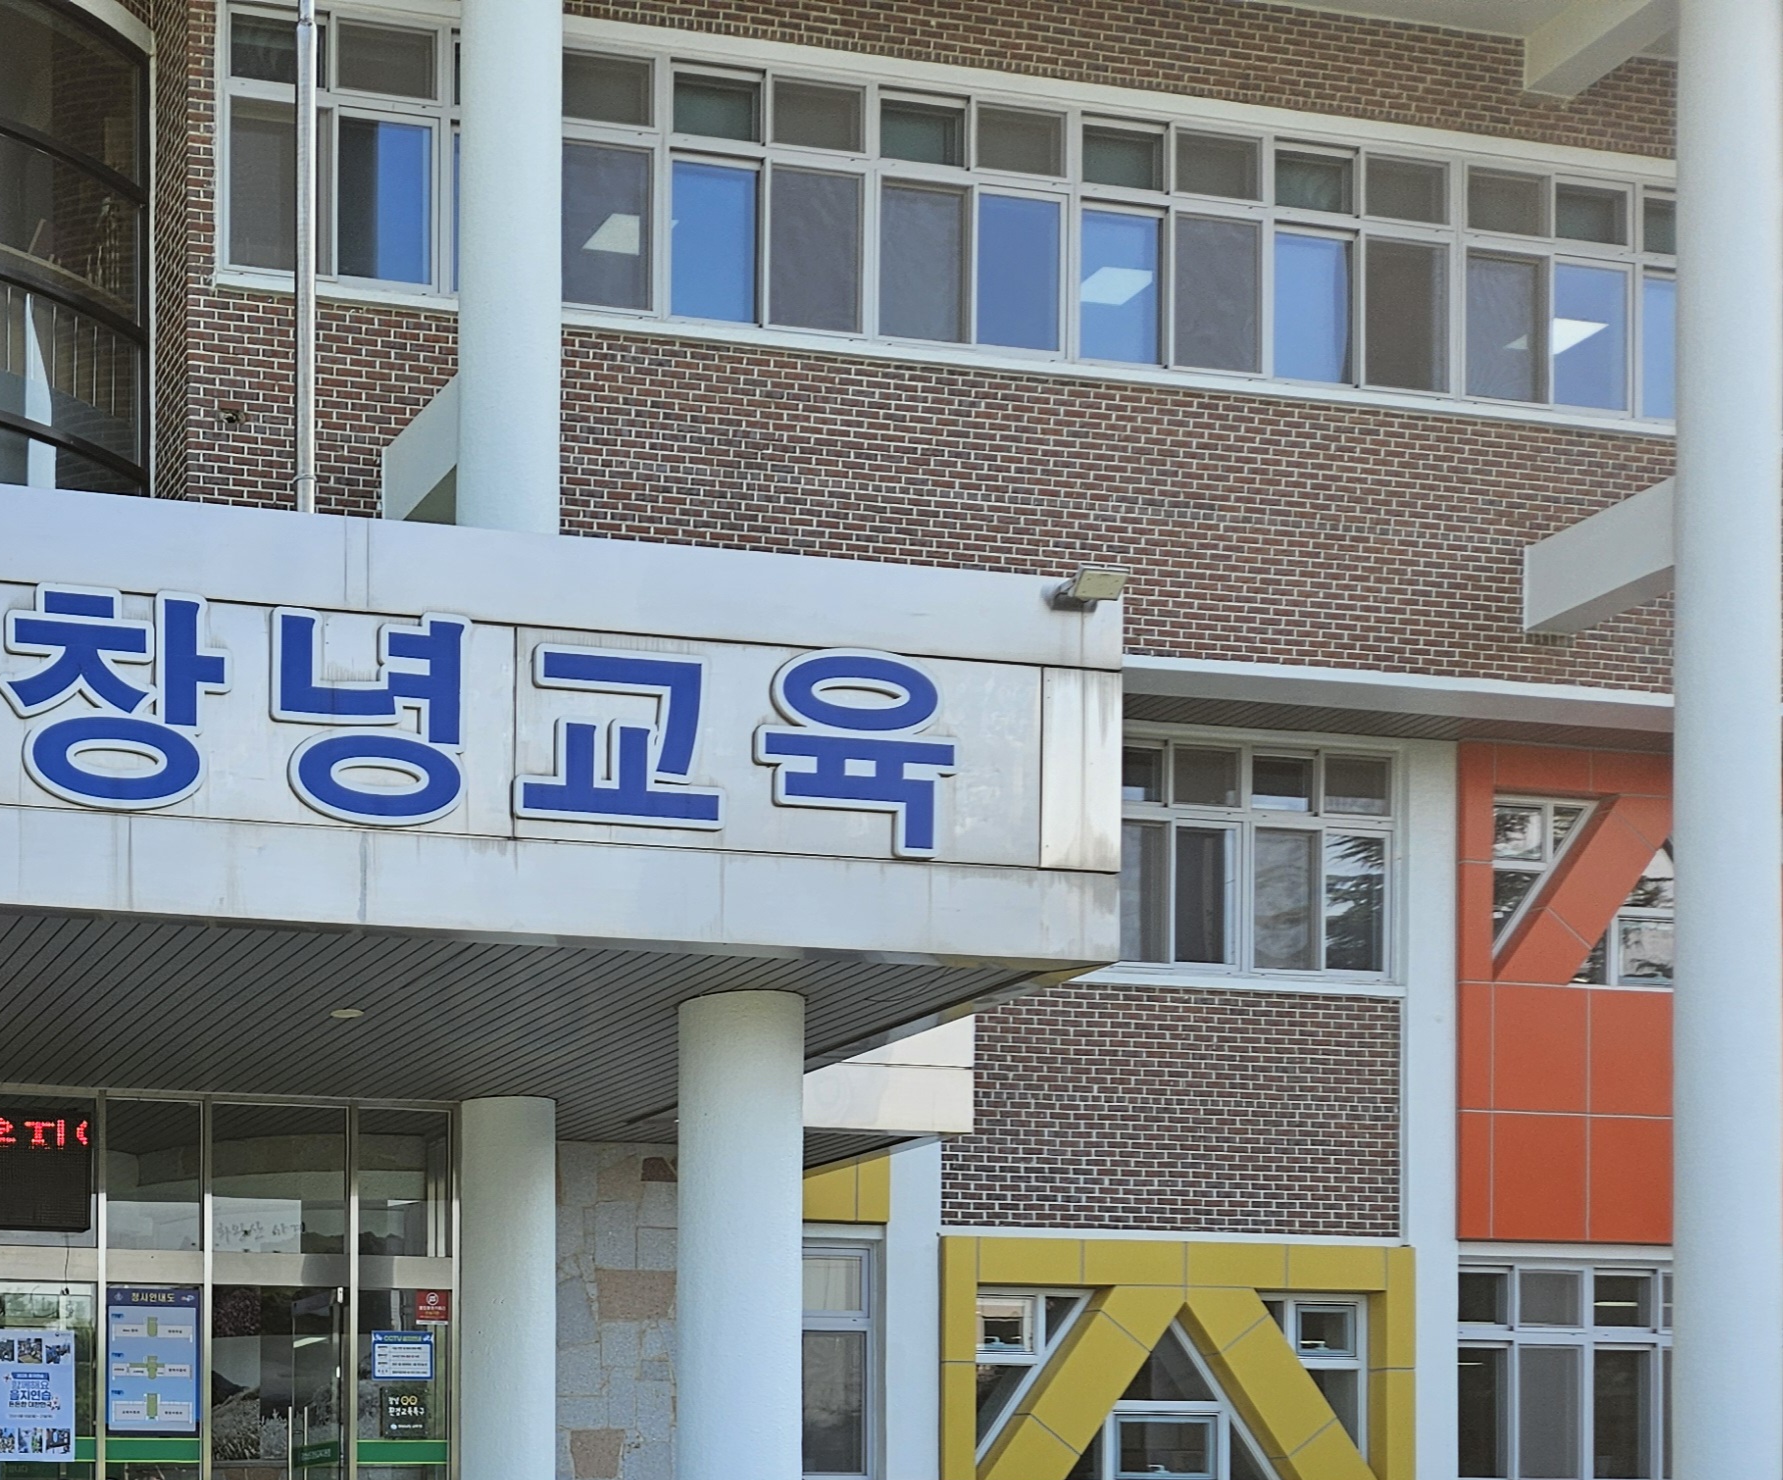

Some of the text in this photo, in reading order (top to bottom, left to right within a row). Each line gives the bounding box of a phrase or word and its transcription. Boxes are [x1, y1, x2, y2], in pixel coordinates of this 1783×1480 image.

[3, 586, 958, 853] 창녕교육
[131, 1292, 176, 1303] 청사안내도
[9, 1389, 52, 1401] 을지연습
